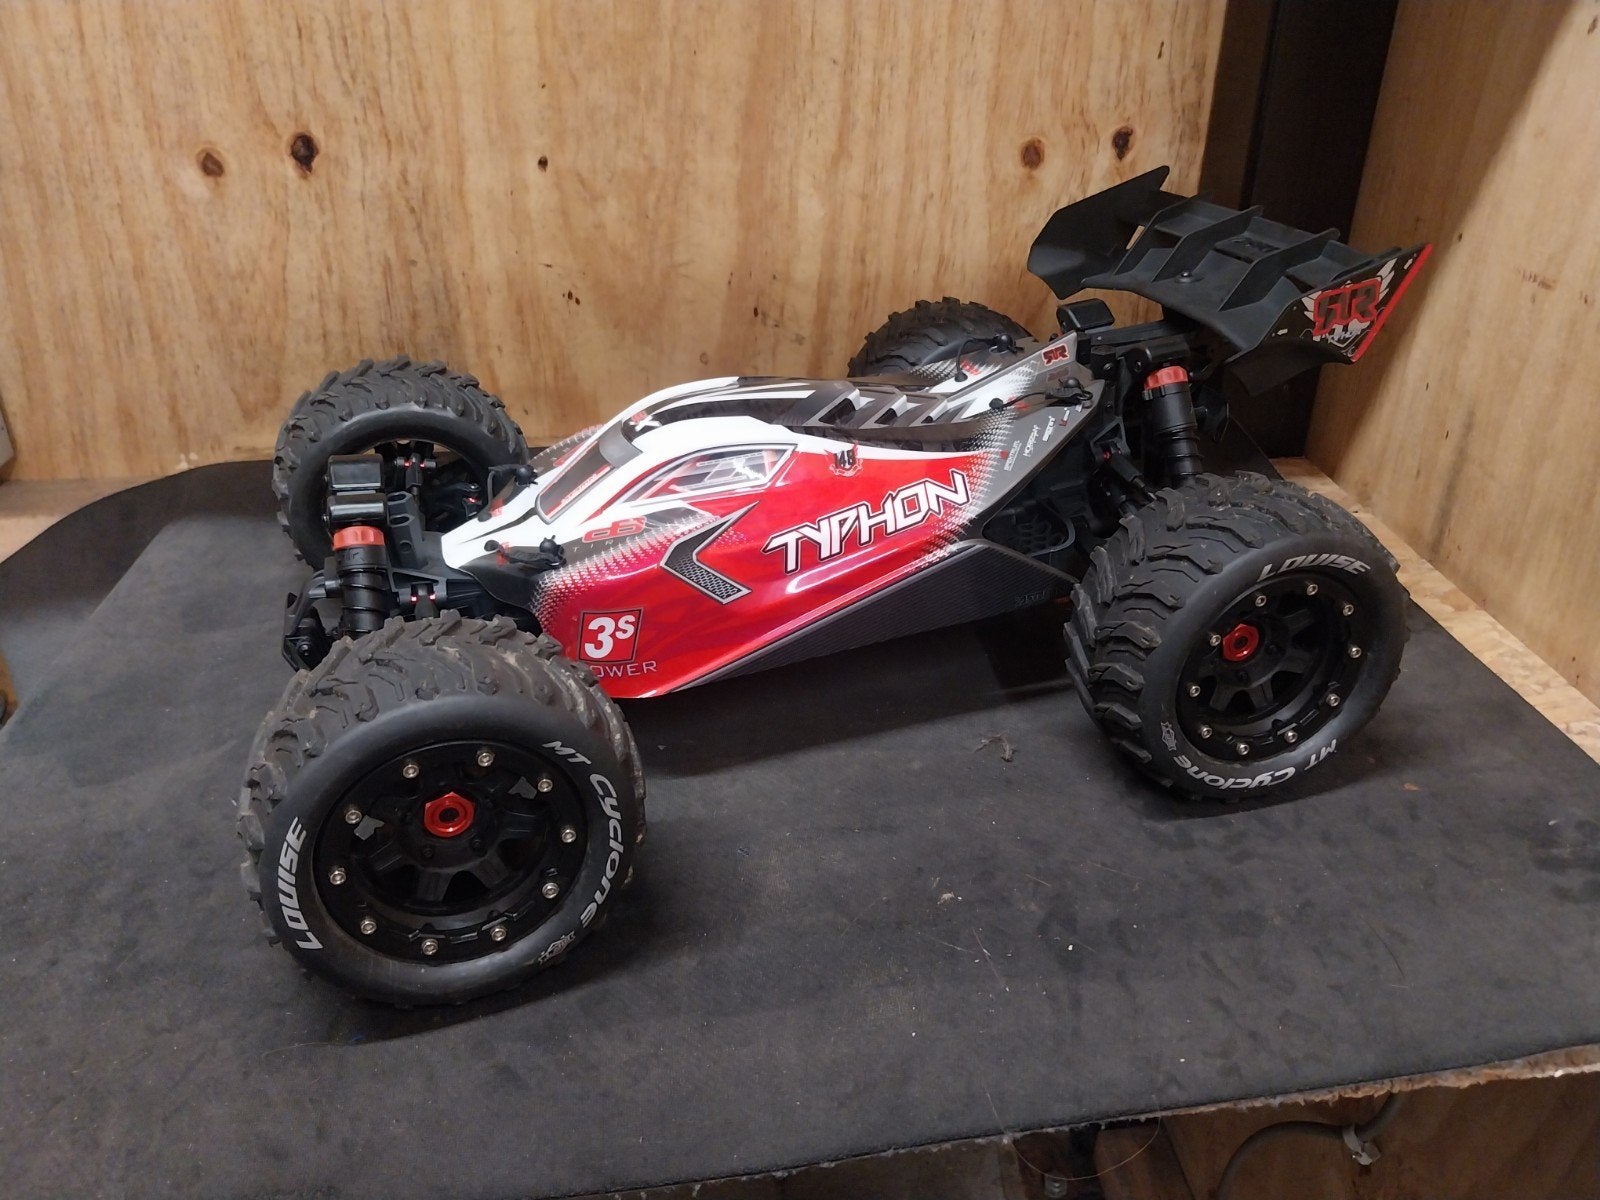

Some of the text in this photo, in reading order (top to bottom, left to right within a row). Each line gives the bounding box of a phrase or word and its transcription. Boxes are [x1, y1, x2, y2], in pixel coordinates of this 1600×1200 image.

[762, 468, 971, 574] TYPHON
[1257, 553, 1371, 582] LOUISE
[589, 660, 657, 678] OWER
[541, 740, 592, 767] MT
[1304, 738, 1338, 771] MT
[278, 816, 323, 951] LOUISE
